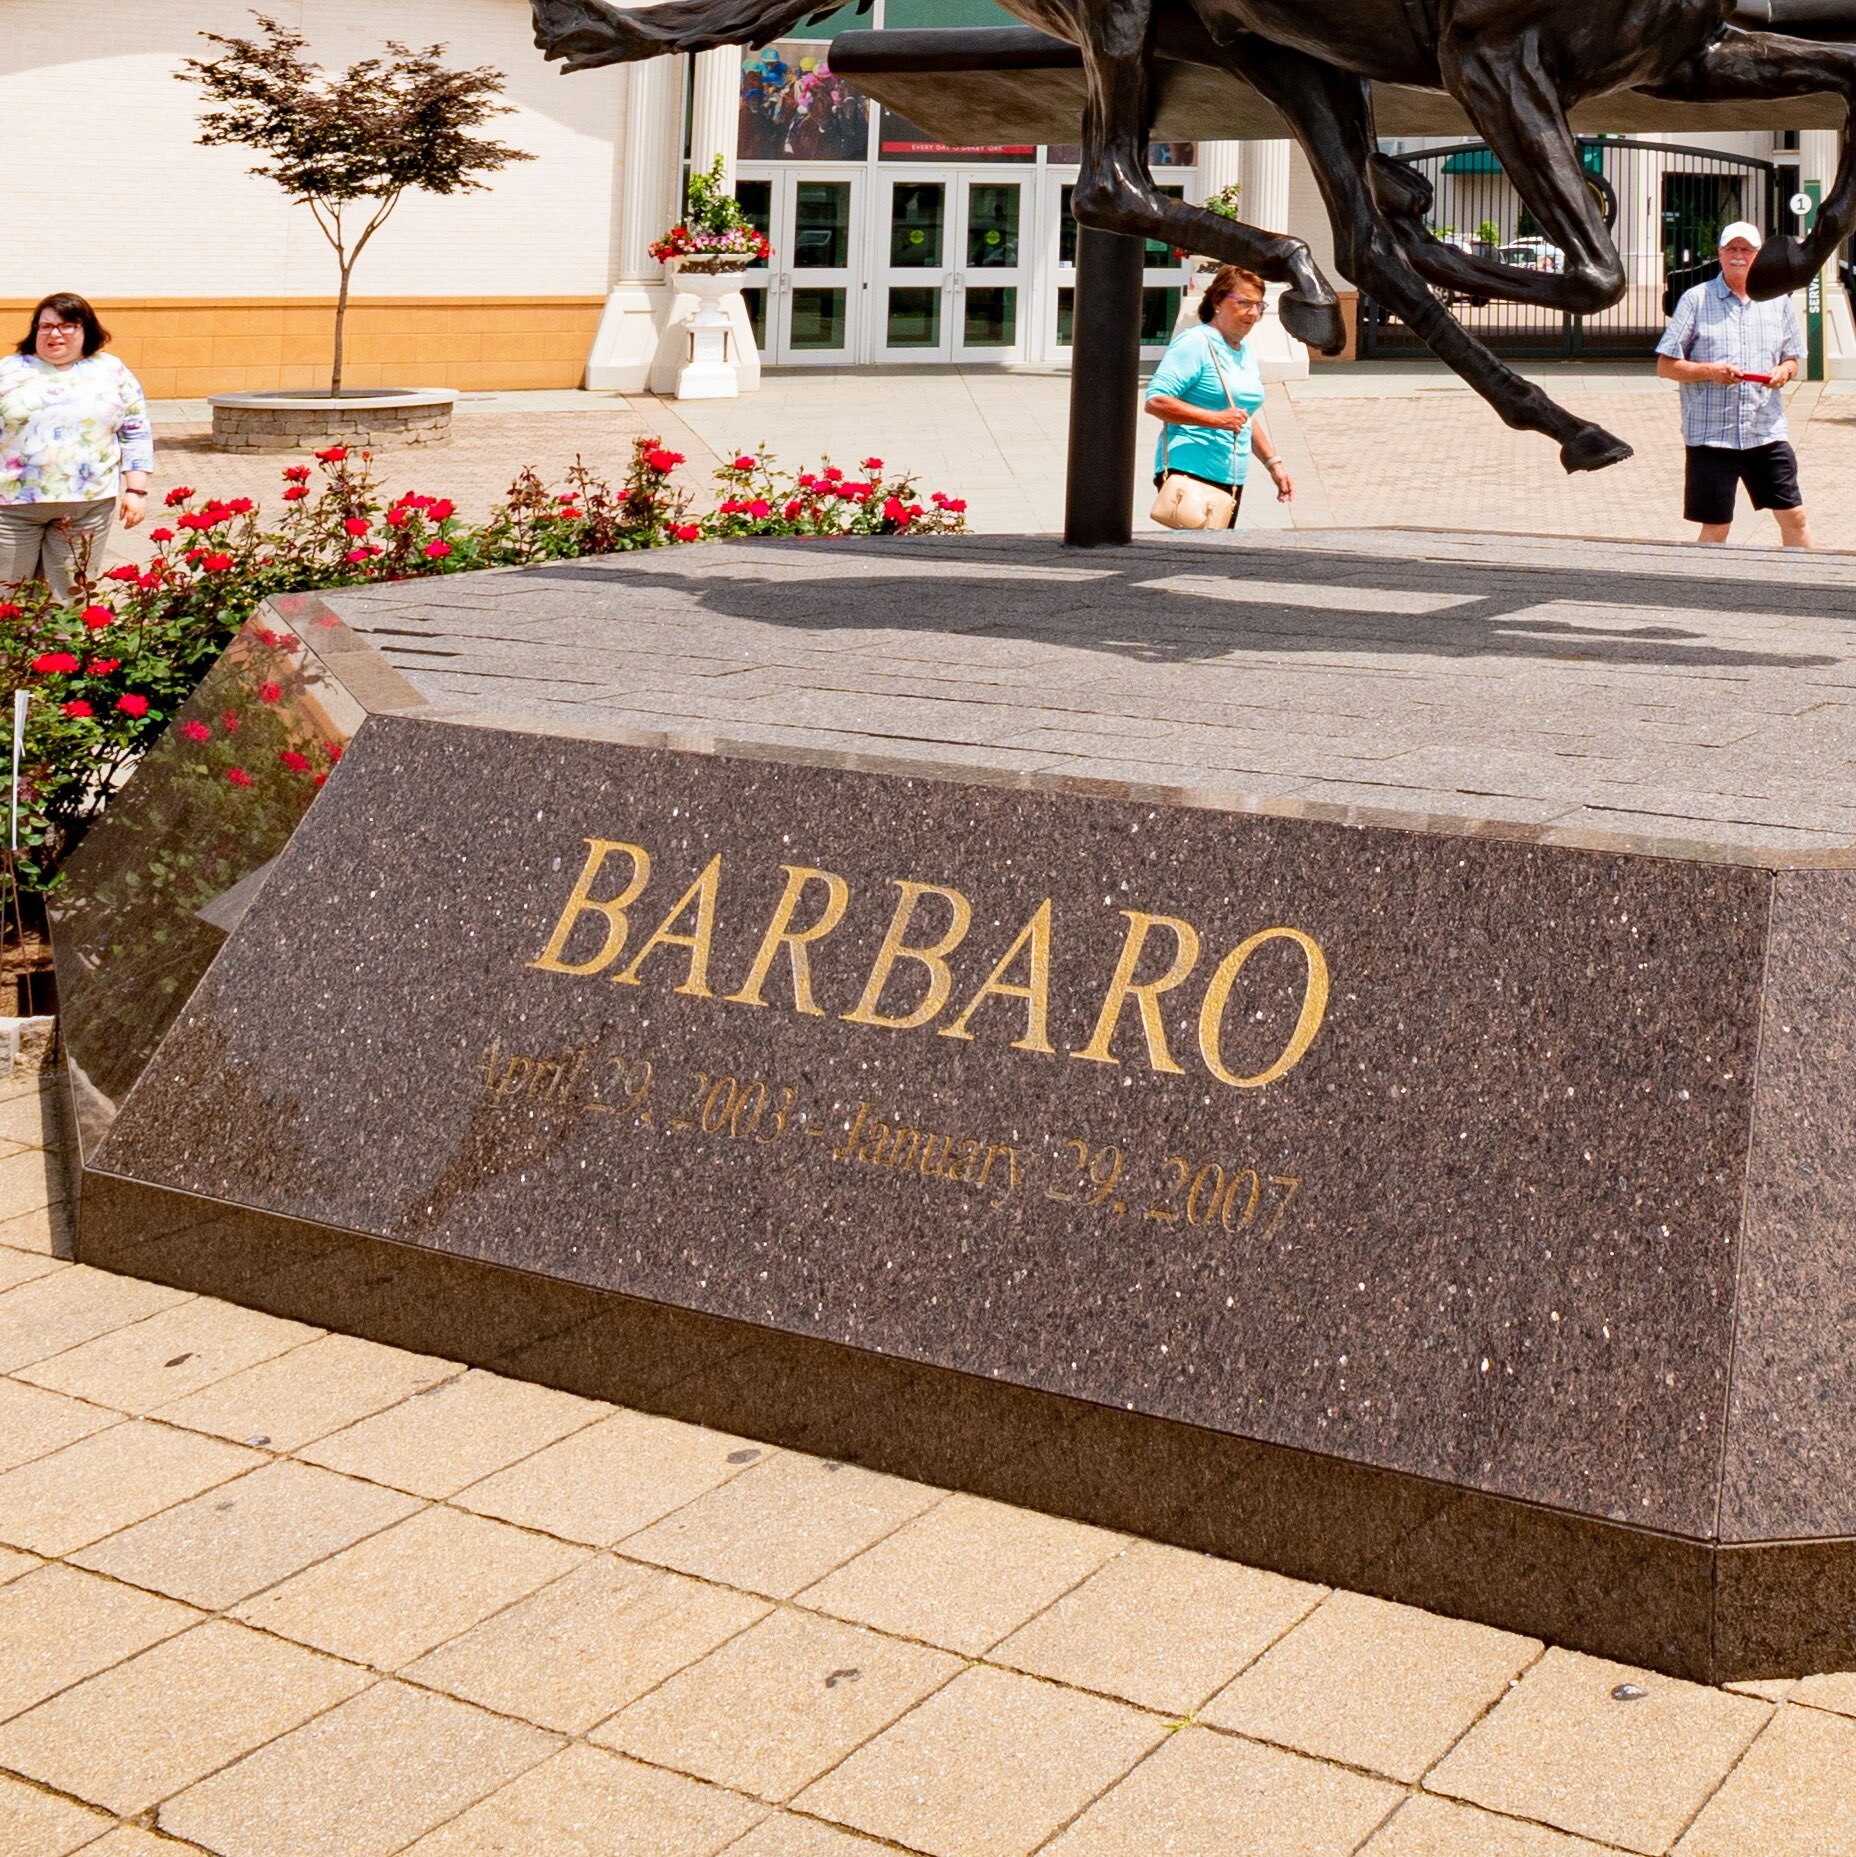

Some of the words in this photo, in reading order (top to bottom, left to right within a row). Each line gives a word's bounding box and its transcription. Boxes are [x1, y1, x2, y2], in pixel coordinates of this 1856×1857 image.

[1797, 197, 1806, 211] 1
[526, 838, 1330, 1088] BARBARO
[667, 1070, 796, 1143] 2003
[833, 1100, 1022, 1208] January
[1044, 1138, 1128, 1218] 29,
[1147, 1154, 1300, 1239] 2007
